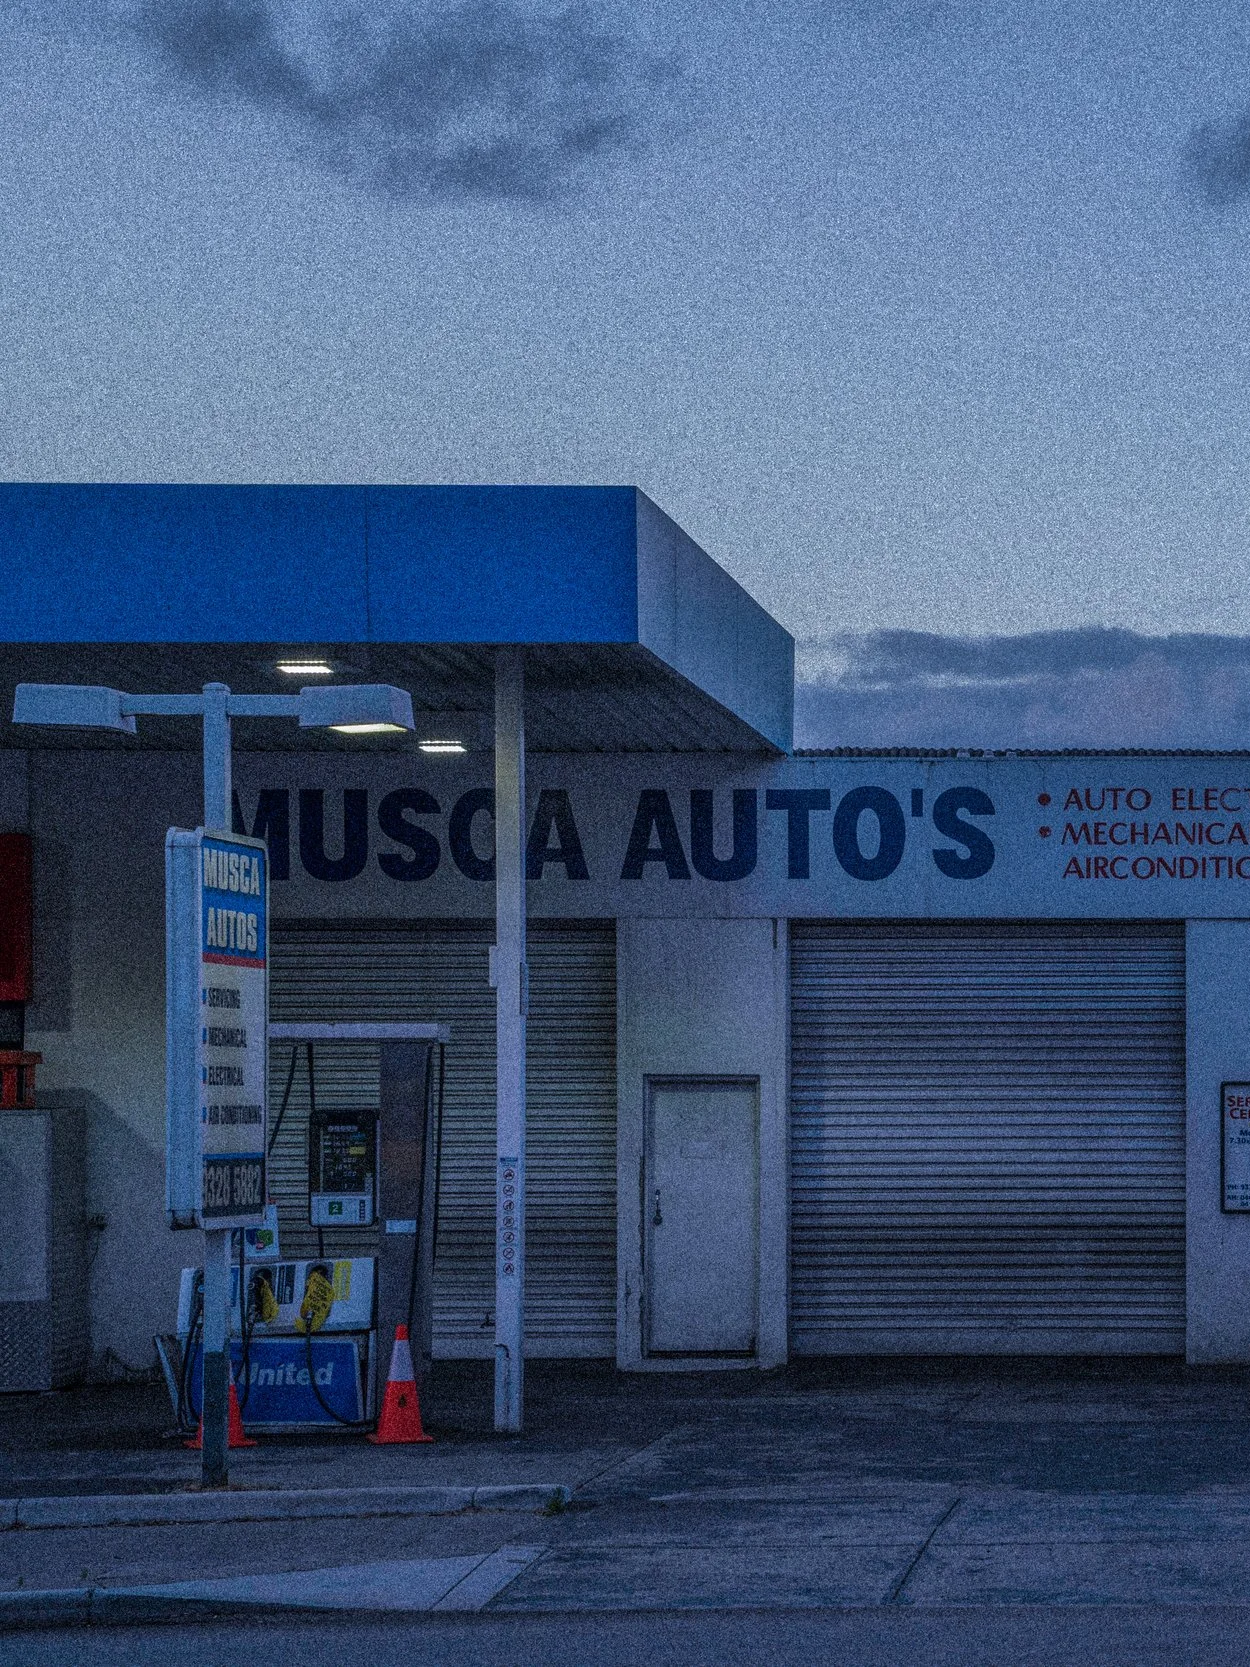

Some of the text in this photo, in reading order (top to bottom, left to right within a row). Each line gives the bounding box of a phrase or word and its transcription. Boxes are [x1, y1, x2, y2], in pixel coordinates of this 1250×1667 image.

[1063, 787, 1152, 812] AUTO
[620, 786, 996, 882] AUTO'S
[203, 847, 260, 896] MUSCA
[207, 907, 258, 952] AUTOS
[208, 987, 240, 1009] SERVICING
[208, 1027, 247, 1049] MECHANICAL
[208, 1066, 244, 1087] ELECTRICAL
[204, 1166, 230, 1207] 328
[239, 1362, 334, 1386] United
